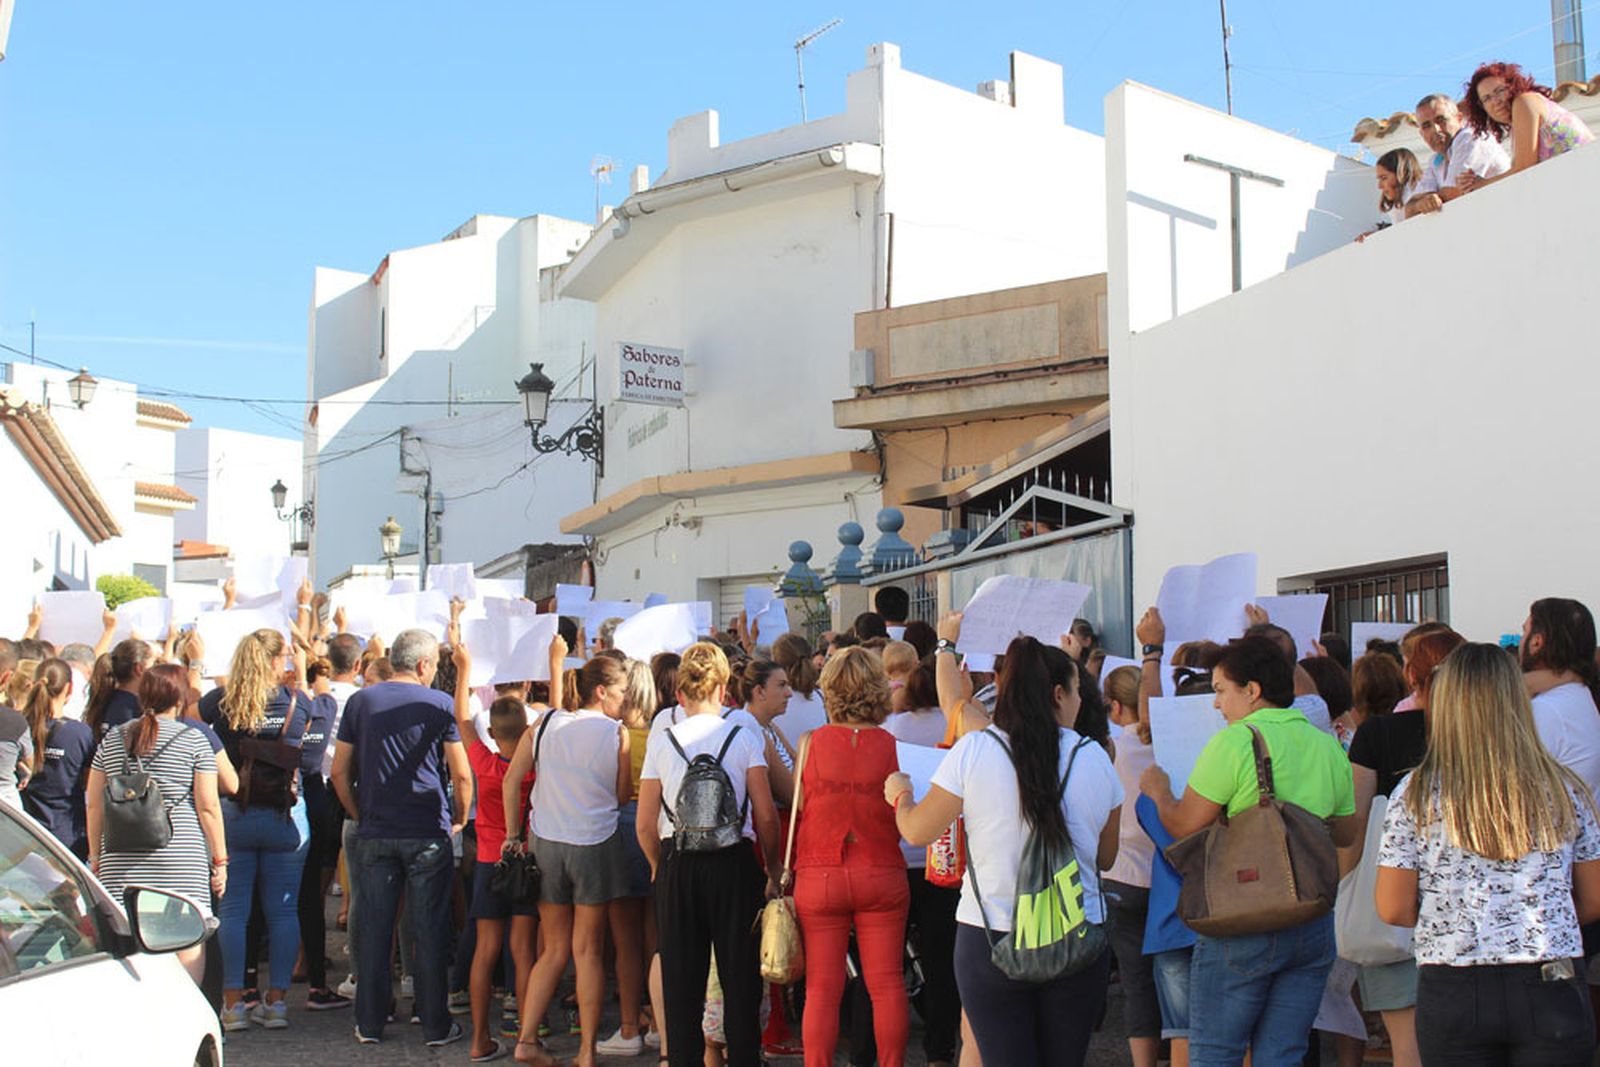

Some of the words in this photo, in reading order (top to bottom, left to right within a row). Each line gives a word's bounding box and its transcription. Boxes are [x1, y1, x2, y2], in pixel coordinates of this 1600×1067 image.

[623, 345, 680, 367] Sabores
[624, 370, 682, 391] Paterna
[1014, 858, 1086, 951] NIKE
